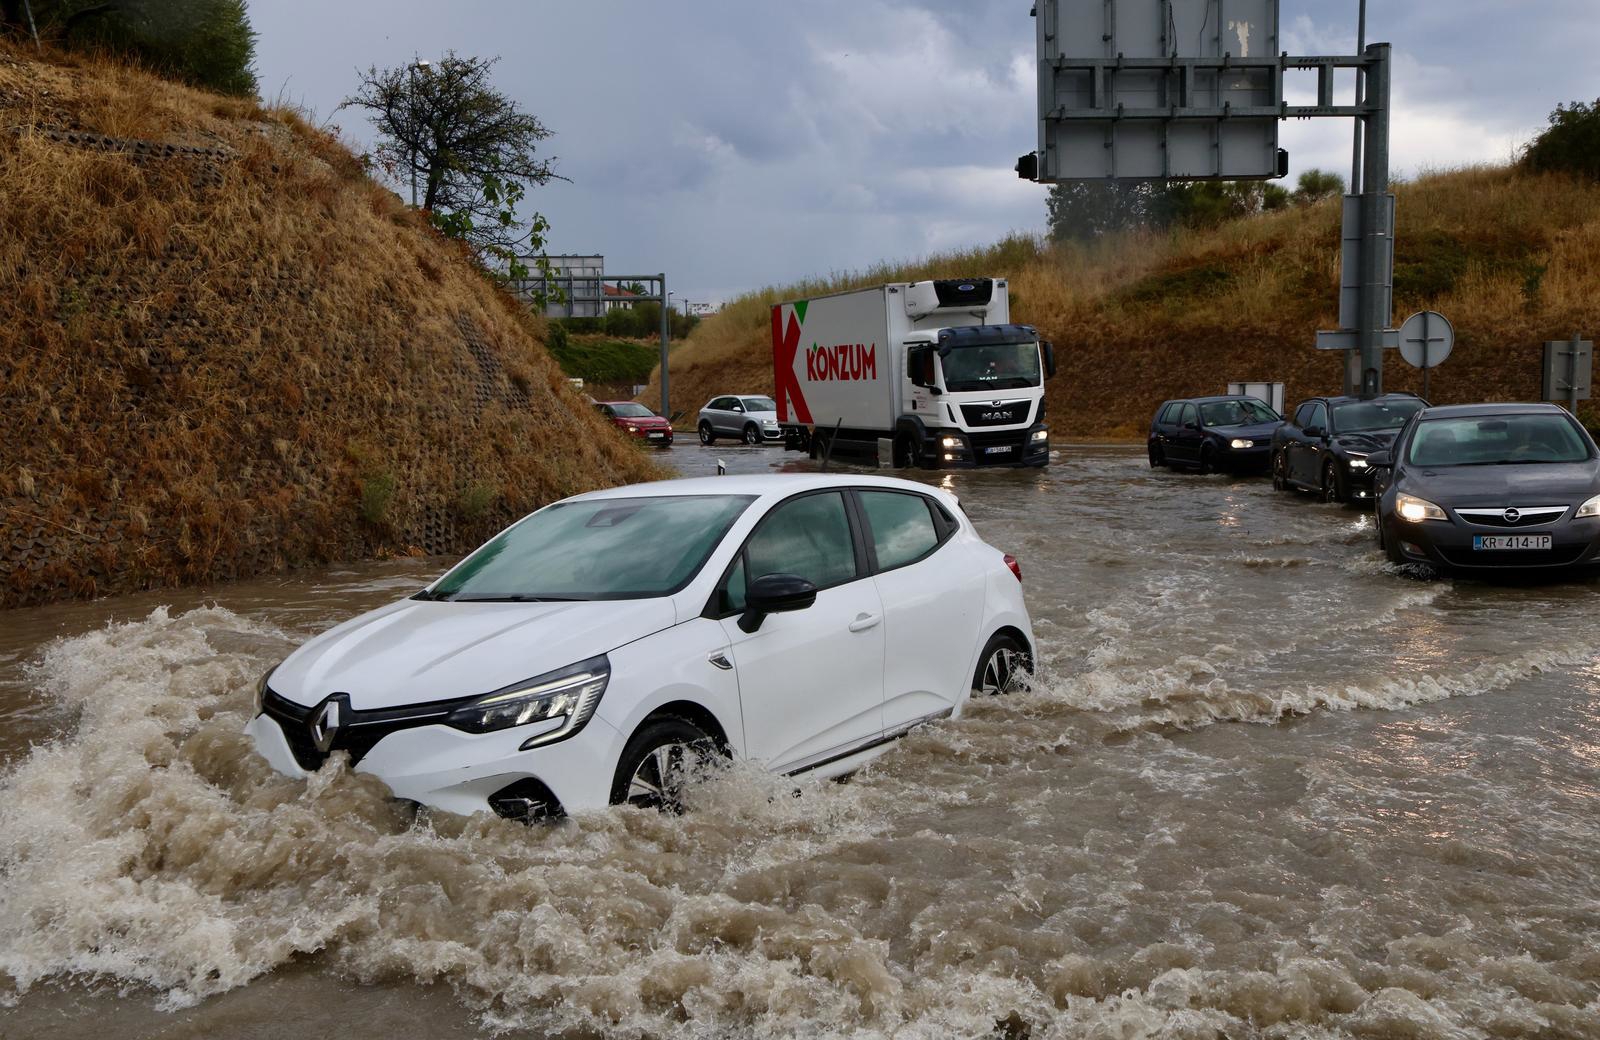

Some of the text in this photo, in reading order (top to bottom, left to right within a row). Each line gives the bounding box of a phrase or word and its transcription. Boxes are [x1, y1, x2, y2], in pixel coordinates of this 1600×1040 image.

[806, 343, 876, 381] KONZUM
[982, 411, 1012, 420] MAN
[1482, 537, 1550, 548] KR 414-IP
